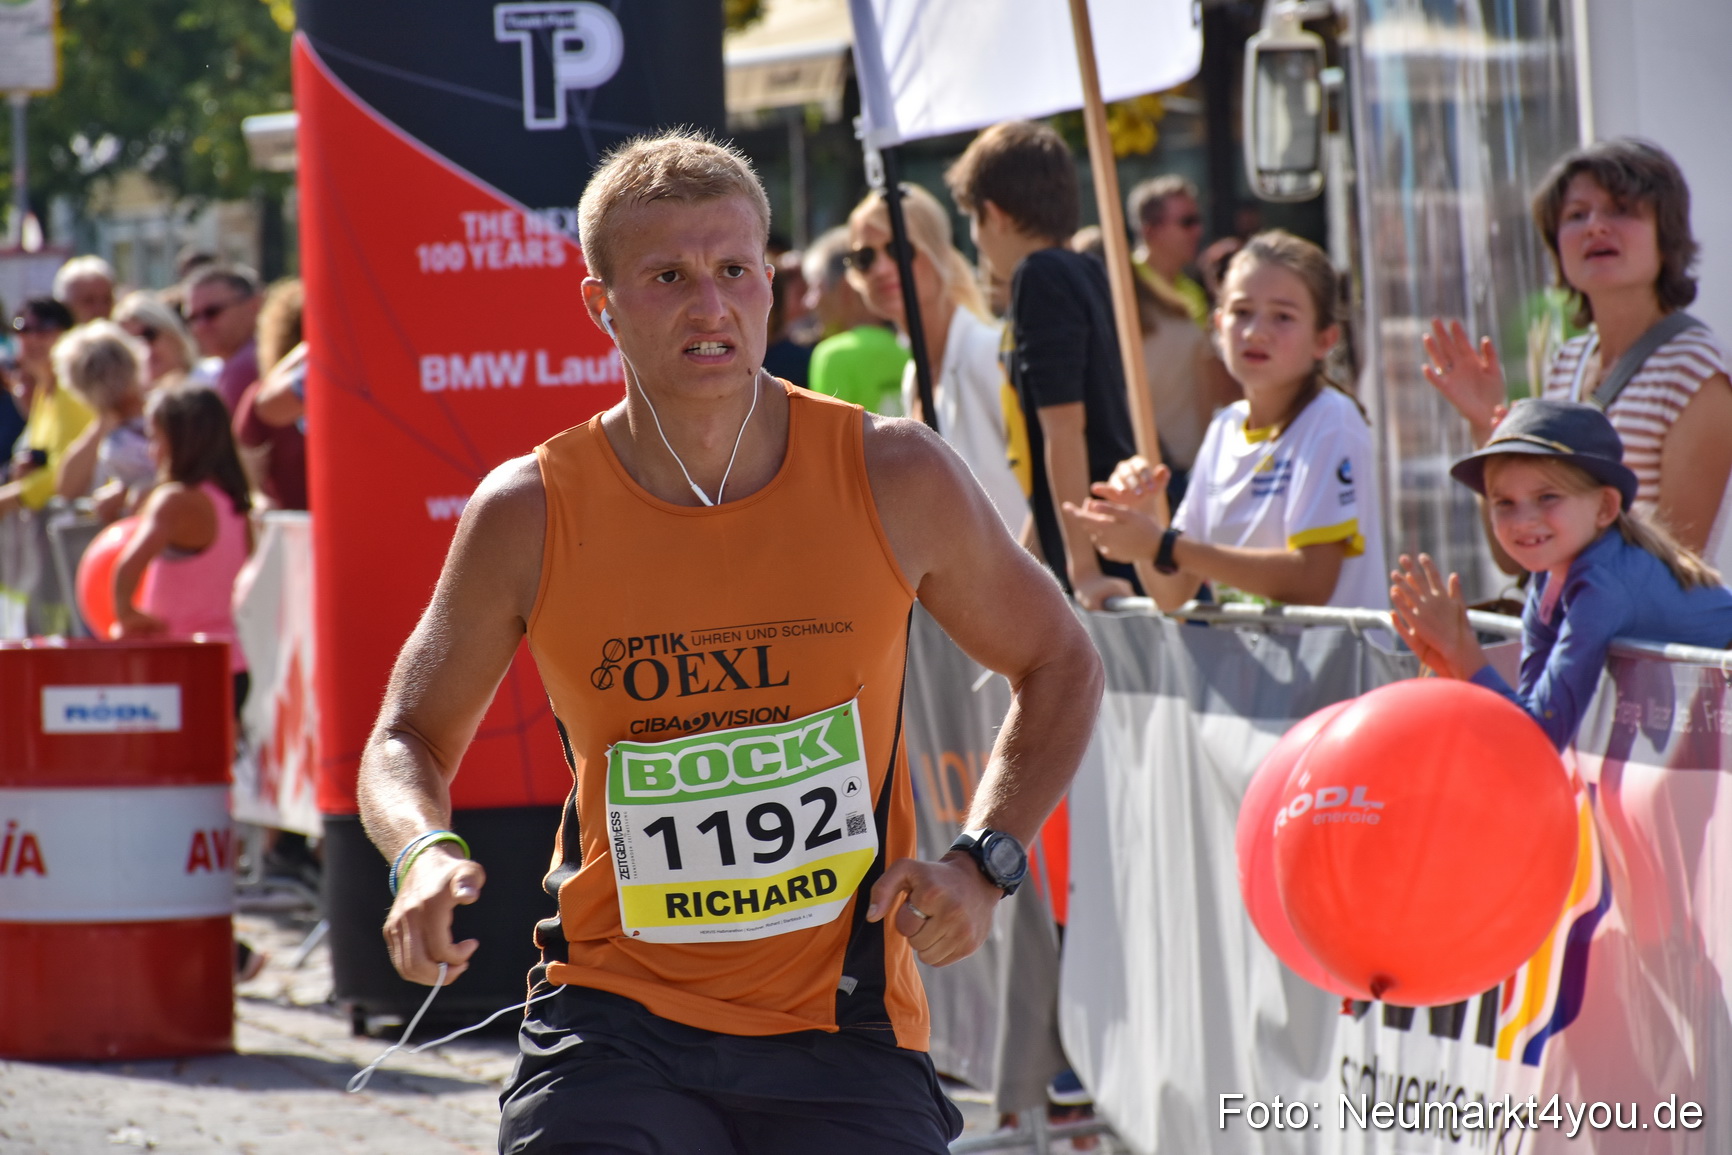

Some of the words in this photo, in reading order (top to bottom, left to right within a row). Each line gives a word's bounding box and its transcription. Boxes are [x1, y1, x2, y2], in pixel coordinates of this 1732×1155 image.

[460, 210, 516, 239] THE
[524, 208, 578, 236] NEX
[417, 242, 466, 272] 100
[468, 239, 567, 270] YEARS
[420, 351, 526, 392] BMW
[535, 346, 623, 386] Lauf
[691, 629, 742, 646] UHREN
[746, 626, 779, 641] UND
[782, 621, 854, 638] SCHMUCK
[623, 645, 790, 702] OEXL
[630, 716, 682, 735] CIBA
[712, 706, 790, 727] VISION
[624, 718, 841, 796] BOCK
[847, 781, 857, 793] A
[643, 786, 842, 870] 1192
[1313, 806, 1381, 825] energie
[665, 869, 838, 918] RICHARD
